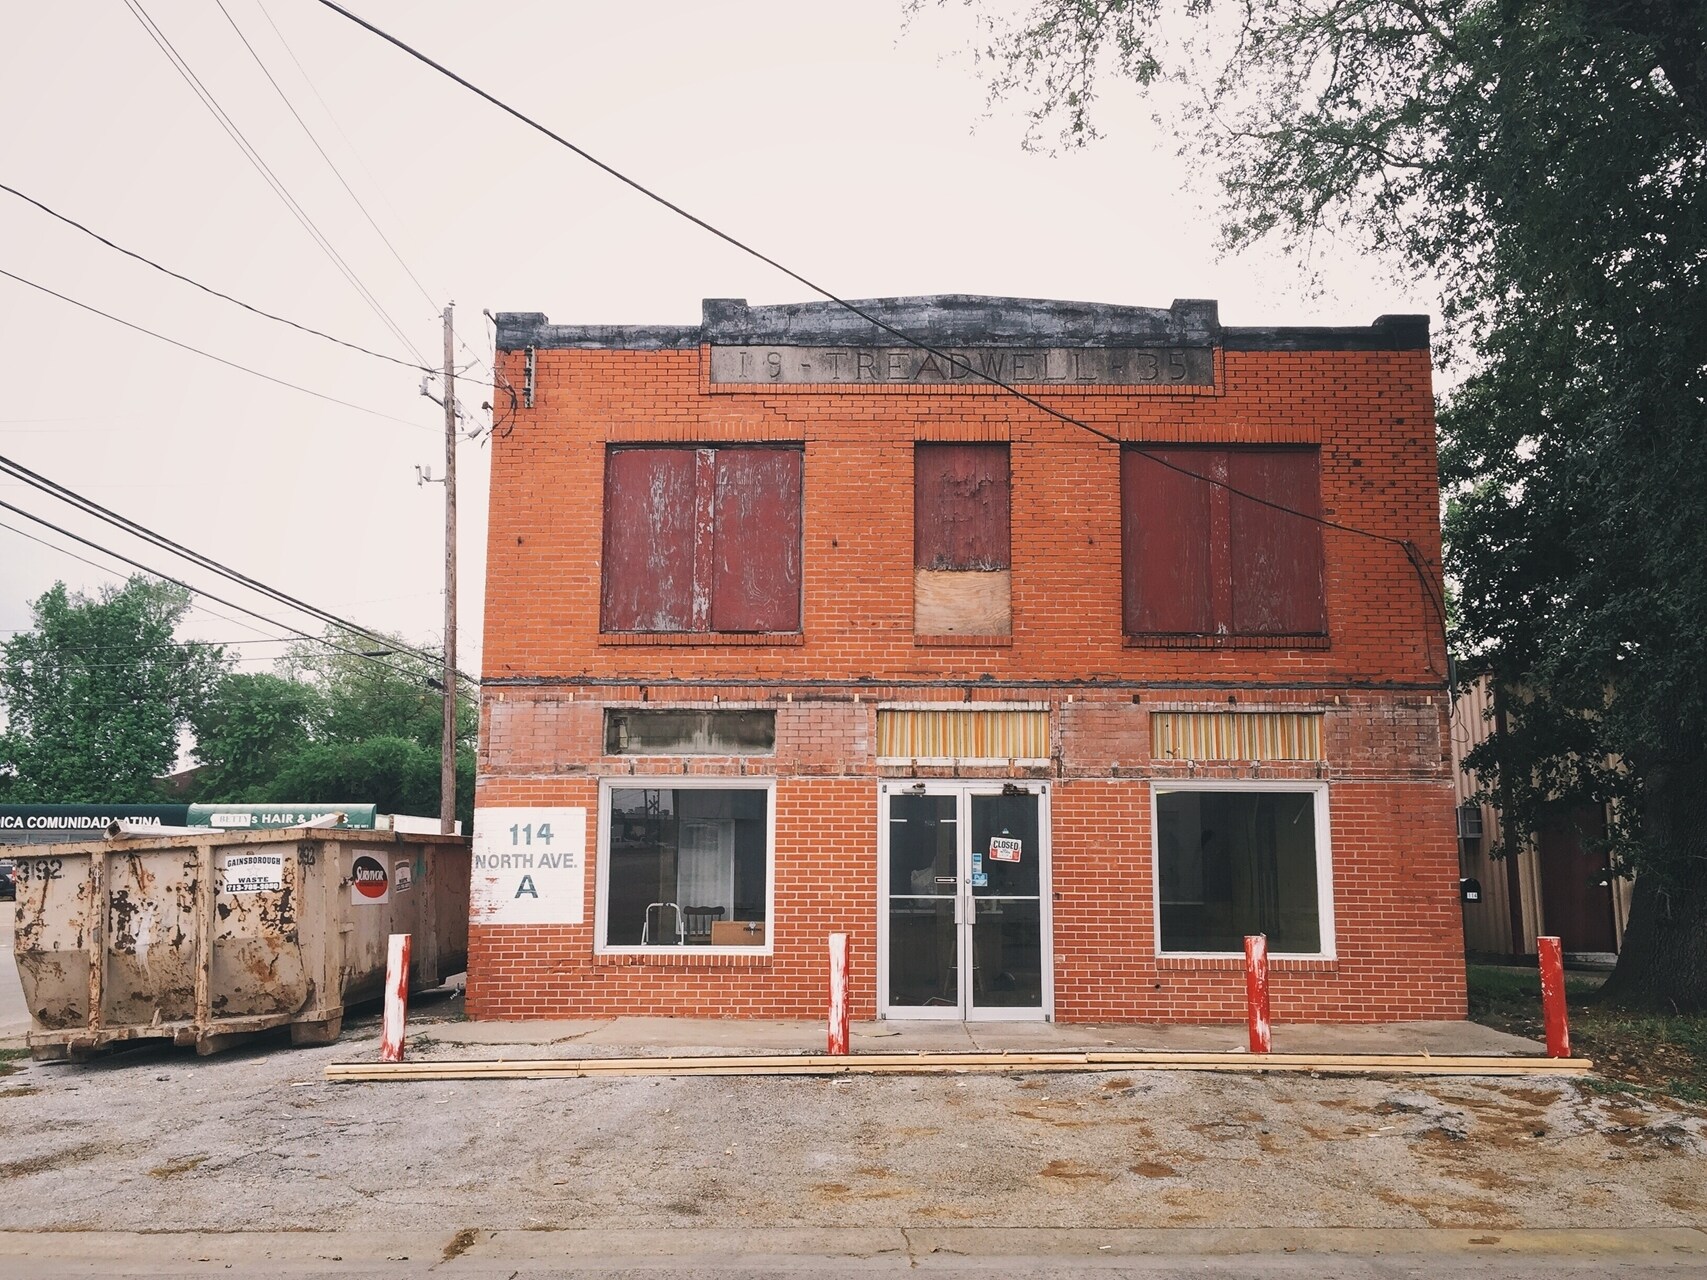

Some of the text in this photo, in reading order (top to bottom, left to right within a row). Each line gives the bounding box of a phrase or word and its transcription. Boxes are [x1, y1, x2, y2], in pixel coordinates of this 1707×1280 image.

[825, 352, 1098, 381] TREADWELL
[27, 816, 110, 829] COMUNIDAD
[262, 813, 293, 824] HAIR
[509, 823, 554, 846] 114
[993, 840, 1019, 850] CLOSED
[227, 856, 281, 868] GAINSBOROUGH
[475, 853, 578, 869] NORTH AVE.
[514, 874, 539, 899] A
